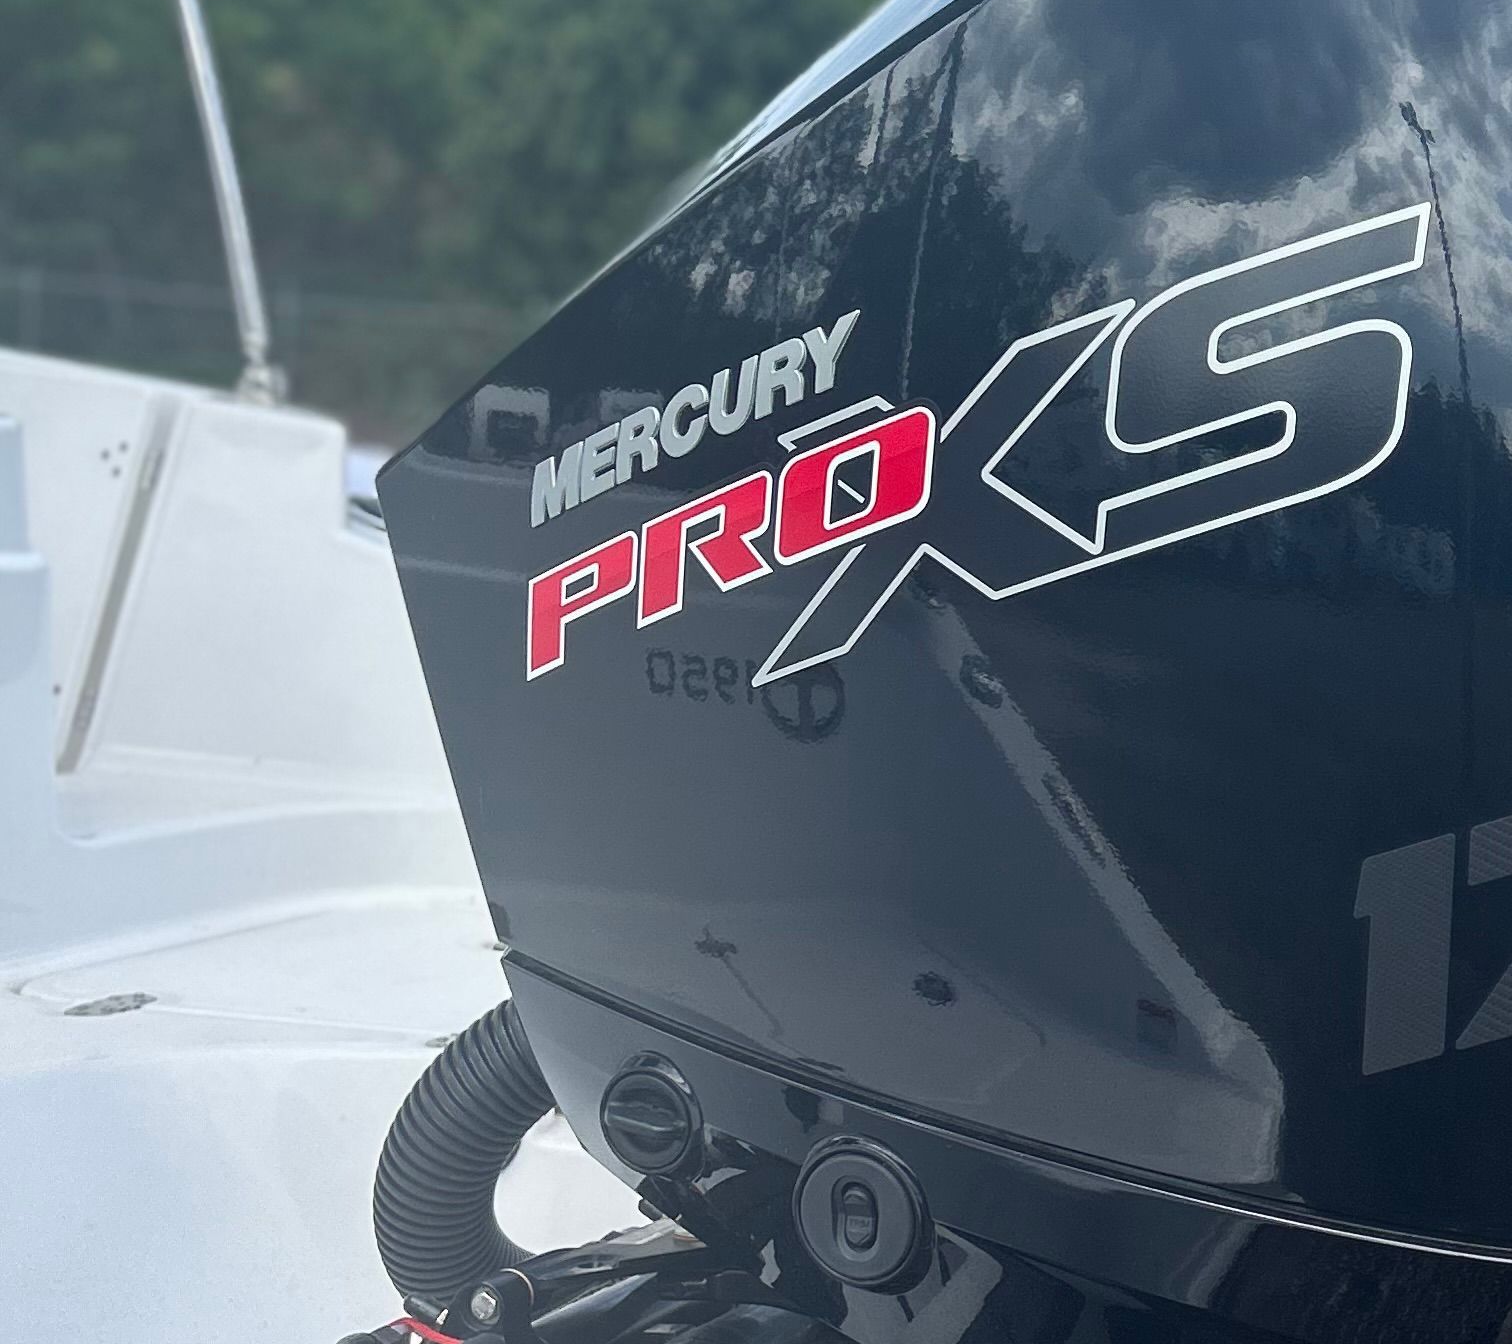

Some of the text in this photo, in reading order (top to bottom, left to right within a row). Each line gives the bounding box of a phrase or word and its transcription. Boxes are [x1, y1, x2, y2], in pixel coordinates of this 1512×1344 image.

[524, 200, 1433, 688] PRO XS
[528, 308, 861, 528] MERCURY
